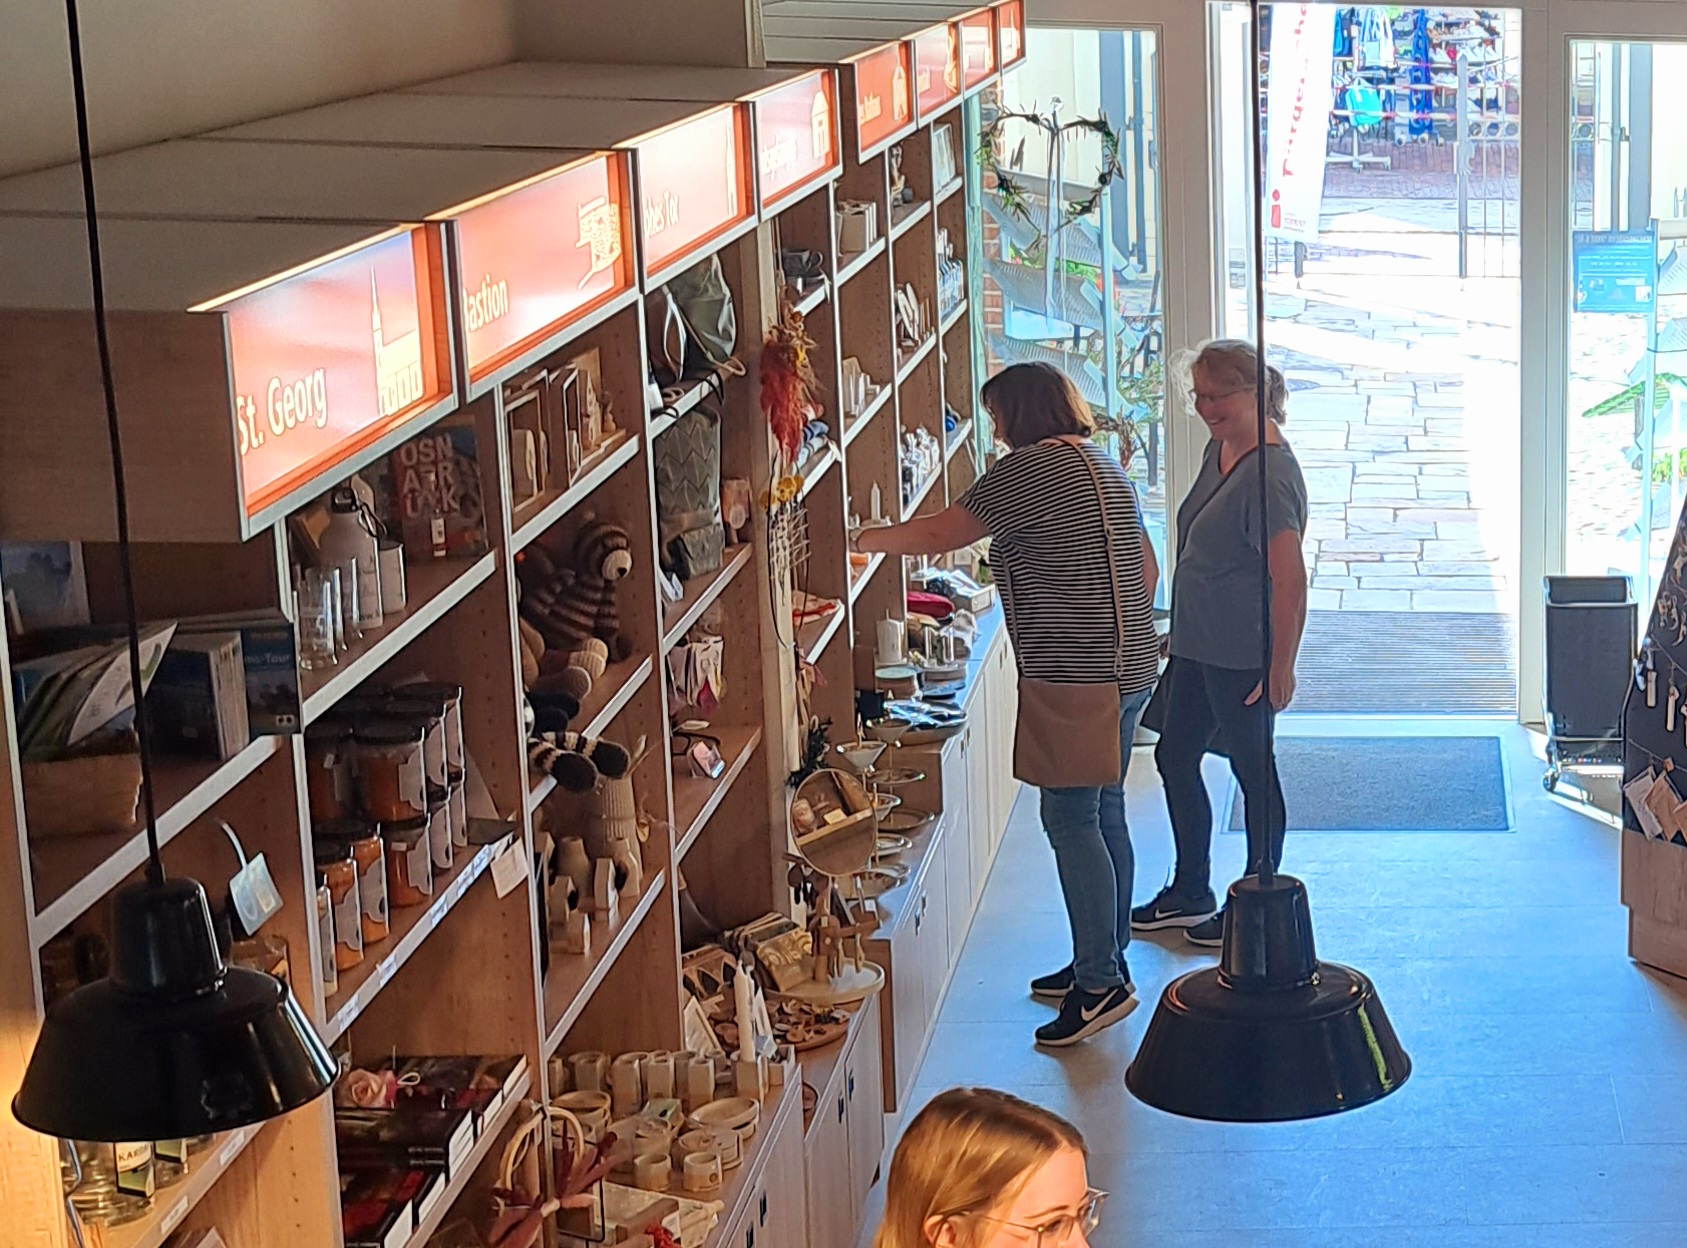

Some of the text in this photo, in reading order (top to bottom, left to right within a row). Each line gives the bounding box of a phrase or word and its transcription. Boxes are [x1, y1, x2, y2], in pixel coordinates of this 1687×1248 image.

[463, 274, 508, 334] astion
[236, 368, 327, 456] St. Georg
